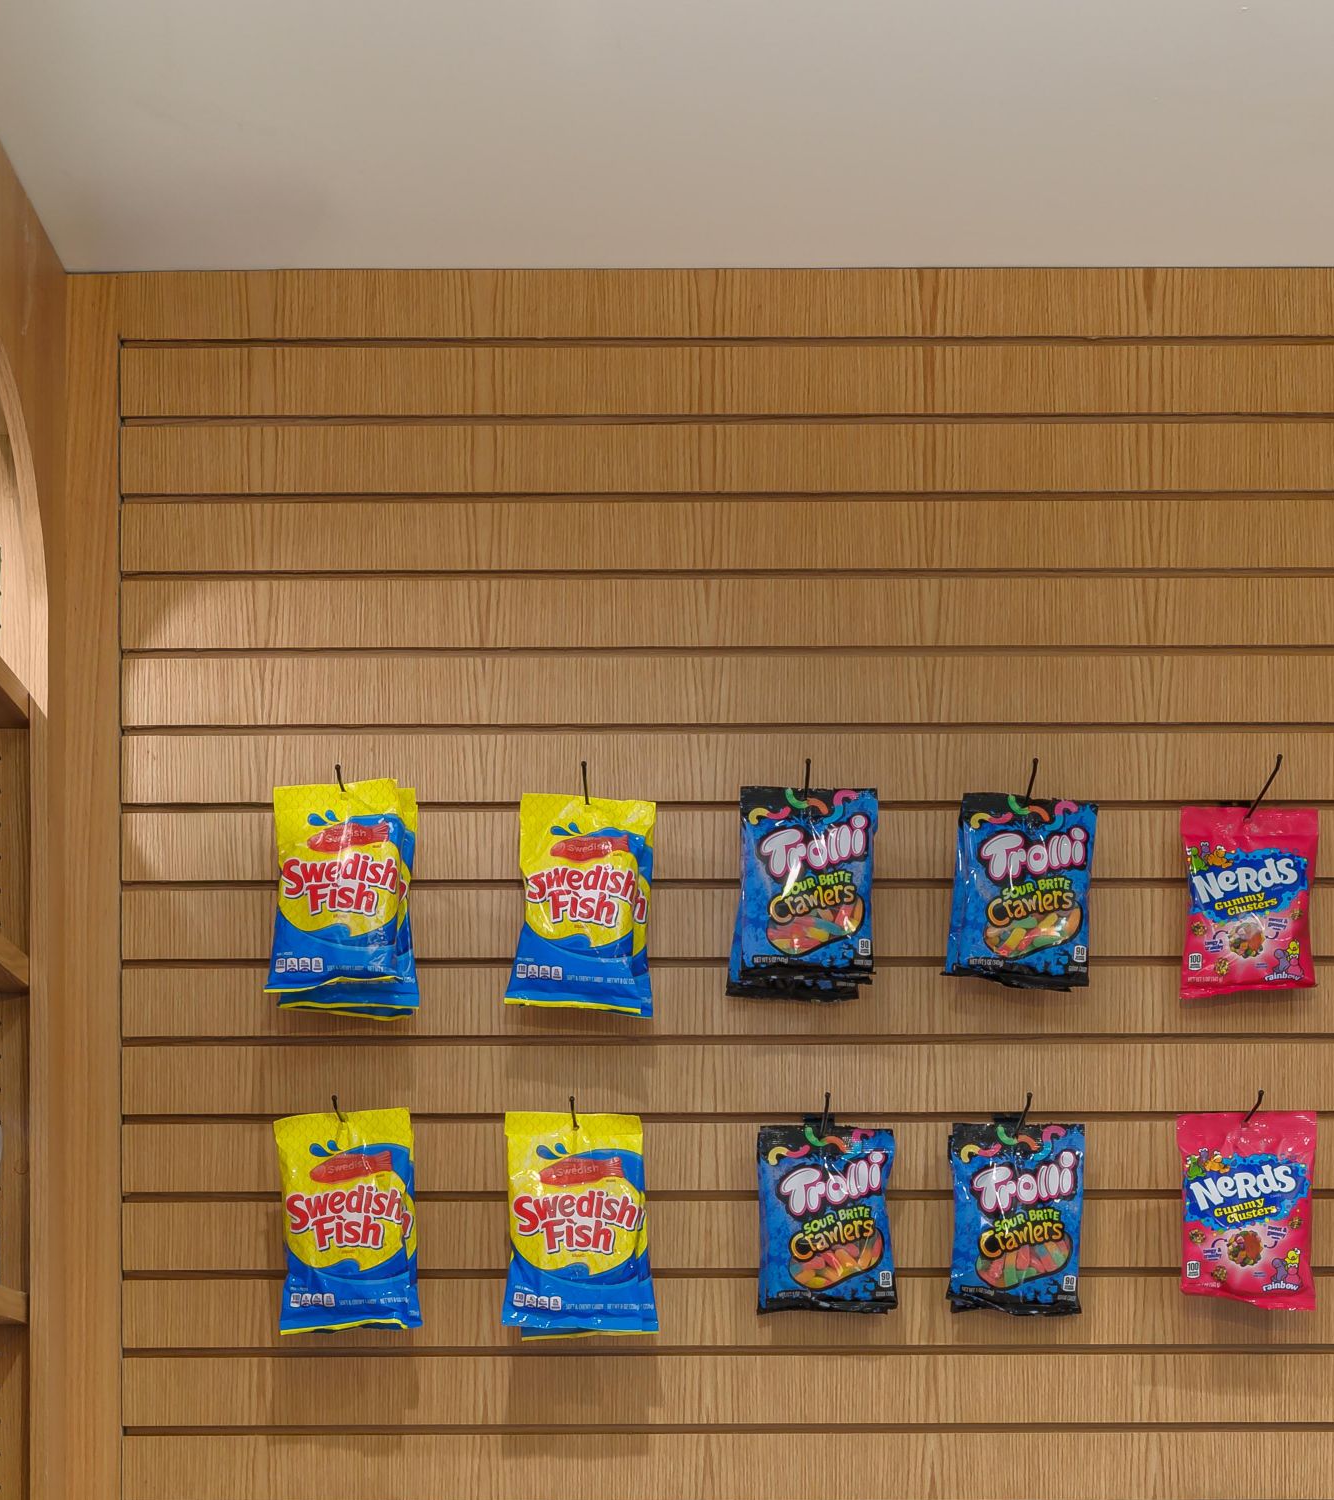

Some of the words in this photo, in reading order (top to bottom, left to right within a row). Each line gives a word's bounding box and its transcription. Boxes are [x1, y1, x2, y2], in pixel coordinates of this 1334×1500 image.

[761, 814, 870, 880] Trolli
[980, 826, 1089, 882] Trolli
[281, 850, 399, 900] Swedish
[526, 861, 638, 906] Swedish
[305, 881, 380, 917] Fish
[548, 890, 620, 928] Fish
[768, 883, 855, 924] Crawlers
[985, 889, 1073, 928] Crawlers
[1214, 891, 1265, 912] Gummy
[1227, 897, 1278, 917] Clusters
[1264, 968, 1301, 983] rainbow
[780, 1150, 885, 1217] Trolli
[971, 1150, 1078, 1215] Trolli
[284, 1184, 404, 1230] Swedish
[511, 1189, 641, 1236] Swedish
[1213, 1198, 1265, 1219] Gummy
[1226, 1204, 1277, 1224] Clusters
[312, 1213, 386, 1251] Fish
[541, 1216, 617, 1255] Fish
[789, 1218, 875, 1262] Crawlers
[979, 1221, 1064, 1260] Crawlers
